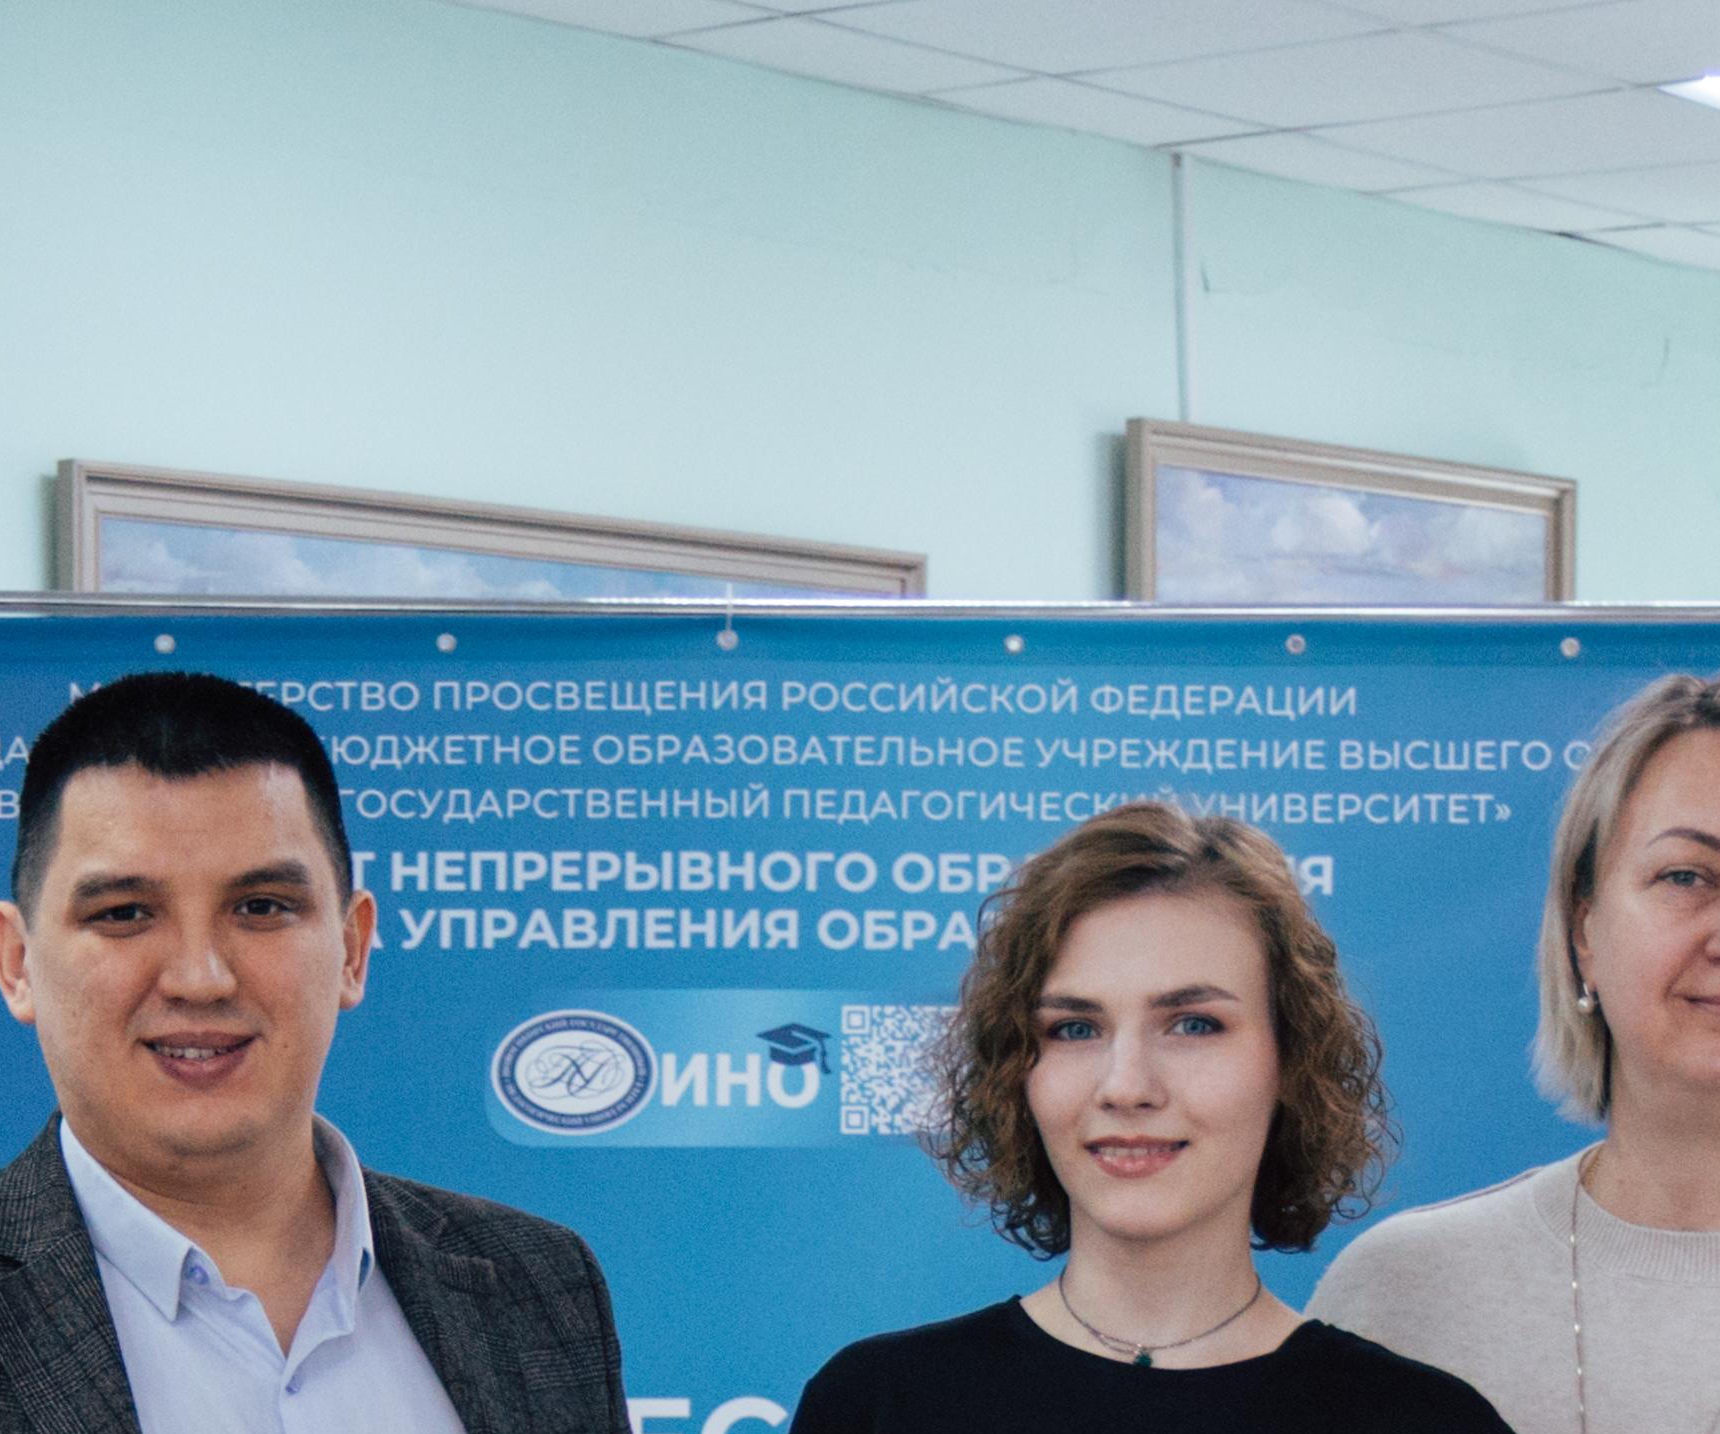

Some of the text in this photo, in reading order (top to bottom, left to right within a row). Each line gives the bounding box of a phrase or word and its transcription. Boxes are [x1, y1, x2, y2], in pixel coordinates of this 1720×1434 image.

[433, 680, 767, 717] ПРОСВЕЩЕНИЯ
[781, 680, 1078, 714] РОССИЙСКОЙ
[1090, 684, 1357, 721] ФЕДЕРАЦИИ
[330, 734, 582, 771] ЮДЖЕТНОЕ
[592, 733, 1025, 768] ОБРАЗОВАТЕЛЬНОЕ
[1035, 738, 1327, 774] УЧРЕЖДЕНИЕ
[1339, 739, 1552, 771] ВЫСШЕГО
[390, 850, 878, 893] НЕПРЕРЫВНОГО
[398, 908, 798, 950] УПРАВЛЕНИЯ
[661, 1052, 819, 1108] ИНО
